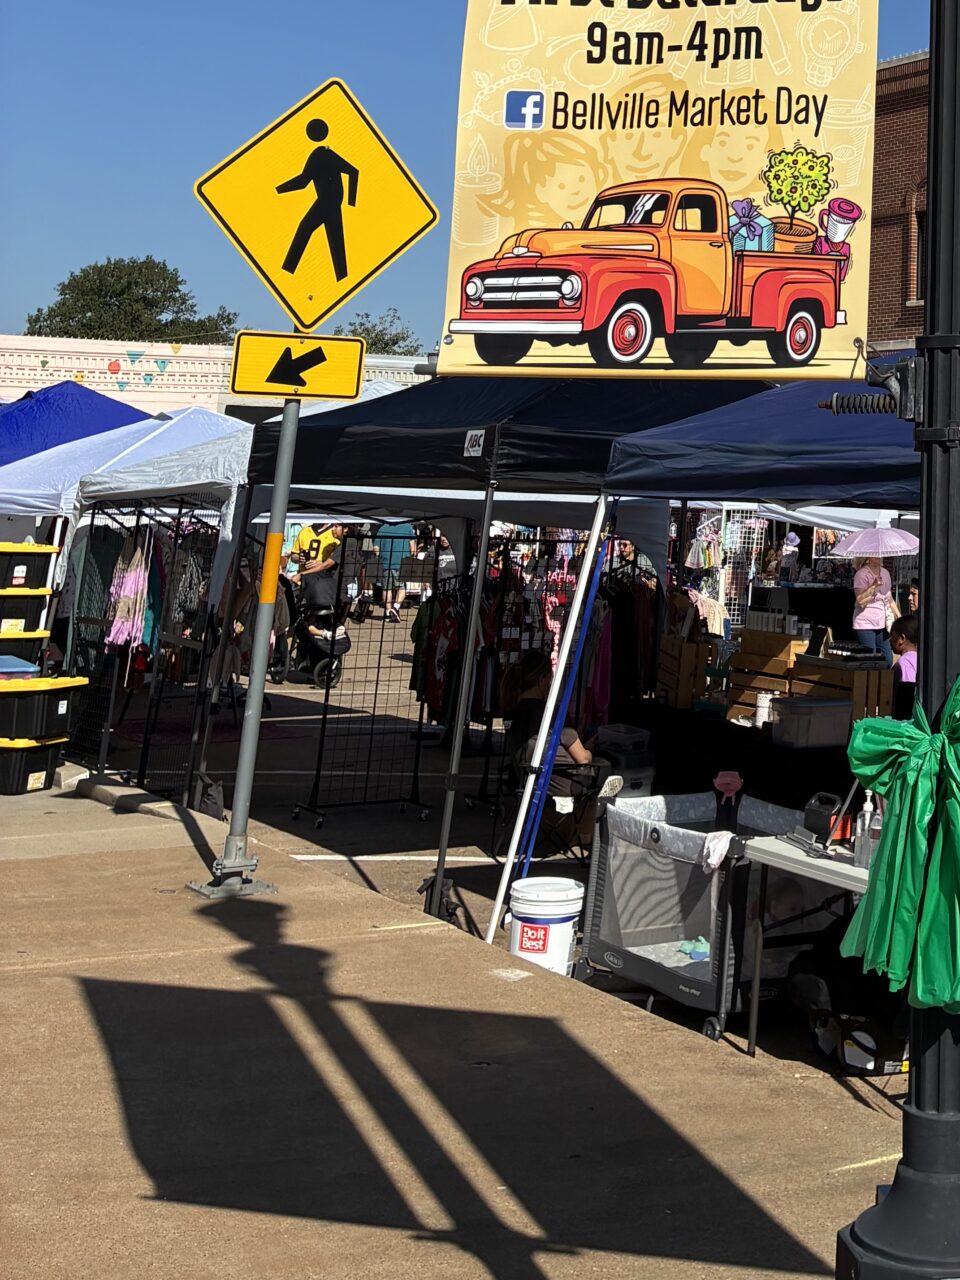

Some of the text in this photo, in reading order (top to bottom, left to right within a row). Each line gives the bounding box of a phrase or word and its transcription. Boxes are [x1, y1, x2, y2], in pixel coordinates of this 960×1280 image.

[586, 21, 764, 69] 9am-4pm
[552, 91, 660, 131] Bellville
[667, 88, 768, 129] Market
[776, 86, 829, 138] Day
[522, 937, 544, 950] Best
[523, 927, 545, 940] Do it
